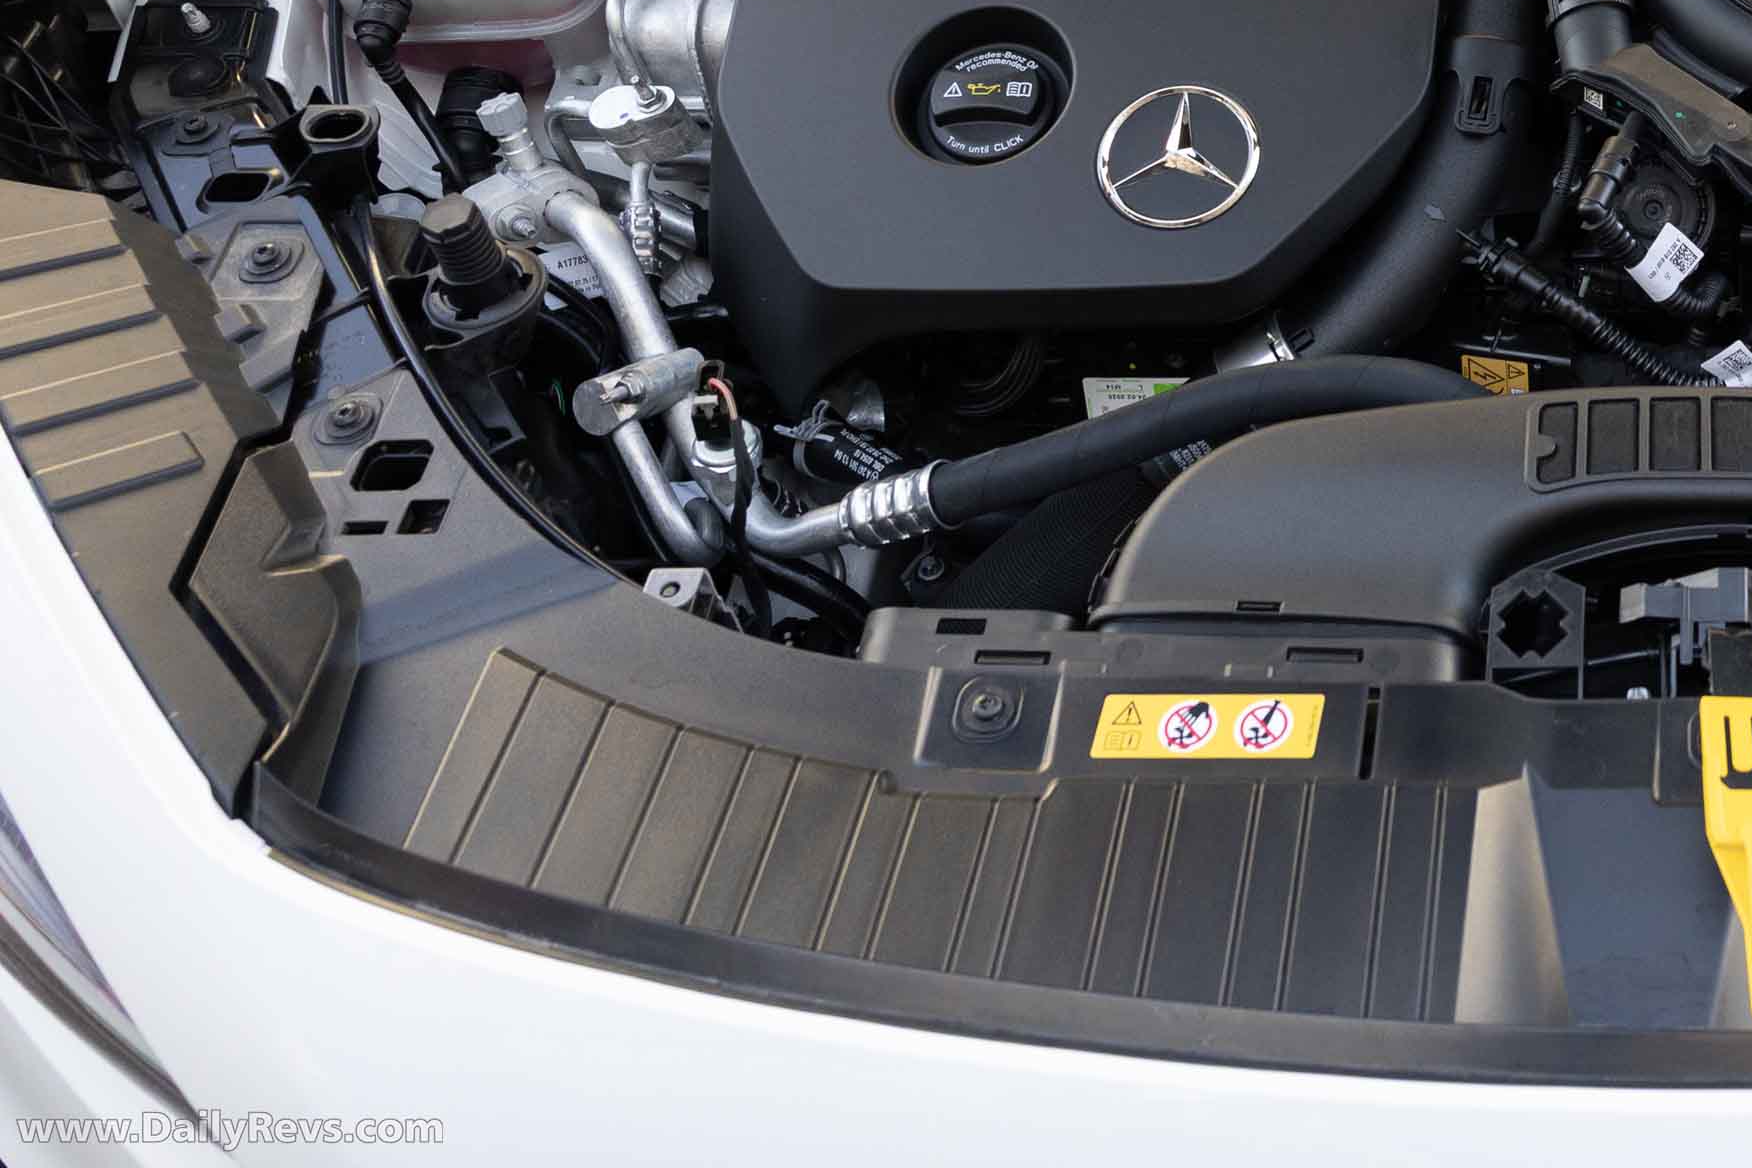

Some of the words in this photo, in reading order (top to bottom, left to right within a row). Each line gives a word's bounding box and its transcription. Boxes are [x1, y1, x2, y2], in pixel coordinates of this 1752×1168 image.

[955, 51, 1027, 71] Mercedes-Benz
[966, 58, 1028, 72] recommended
[946, 135, 966, 151] Turn
[968, 145, 990, 154] until
[993, 134, 1025, 152] CLICK
